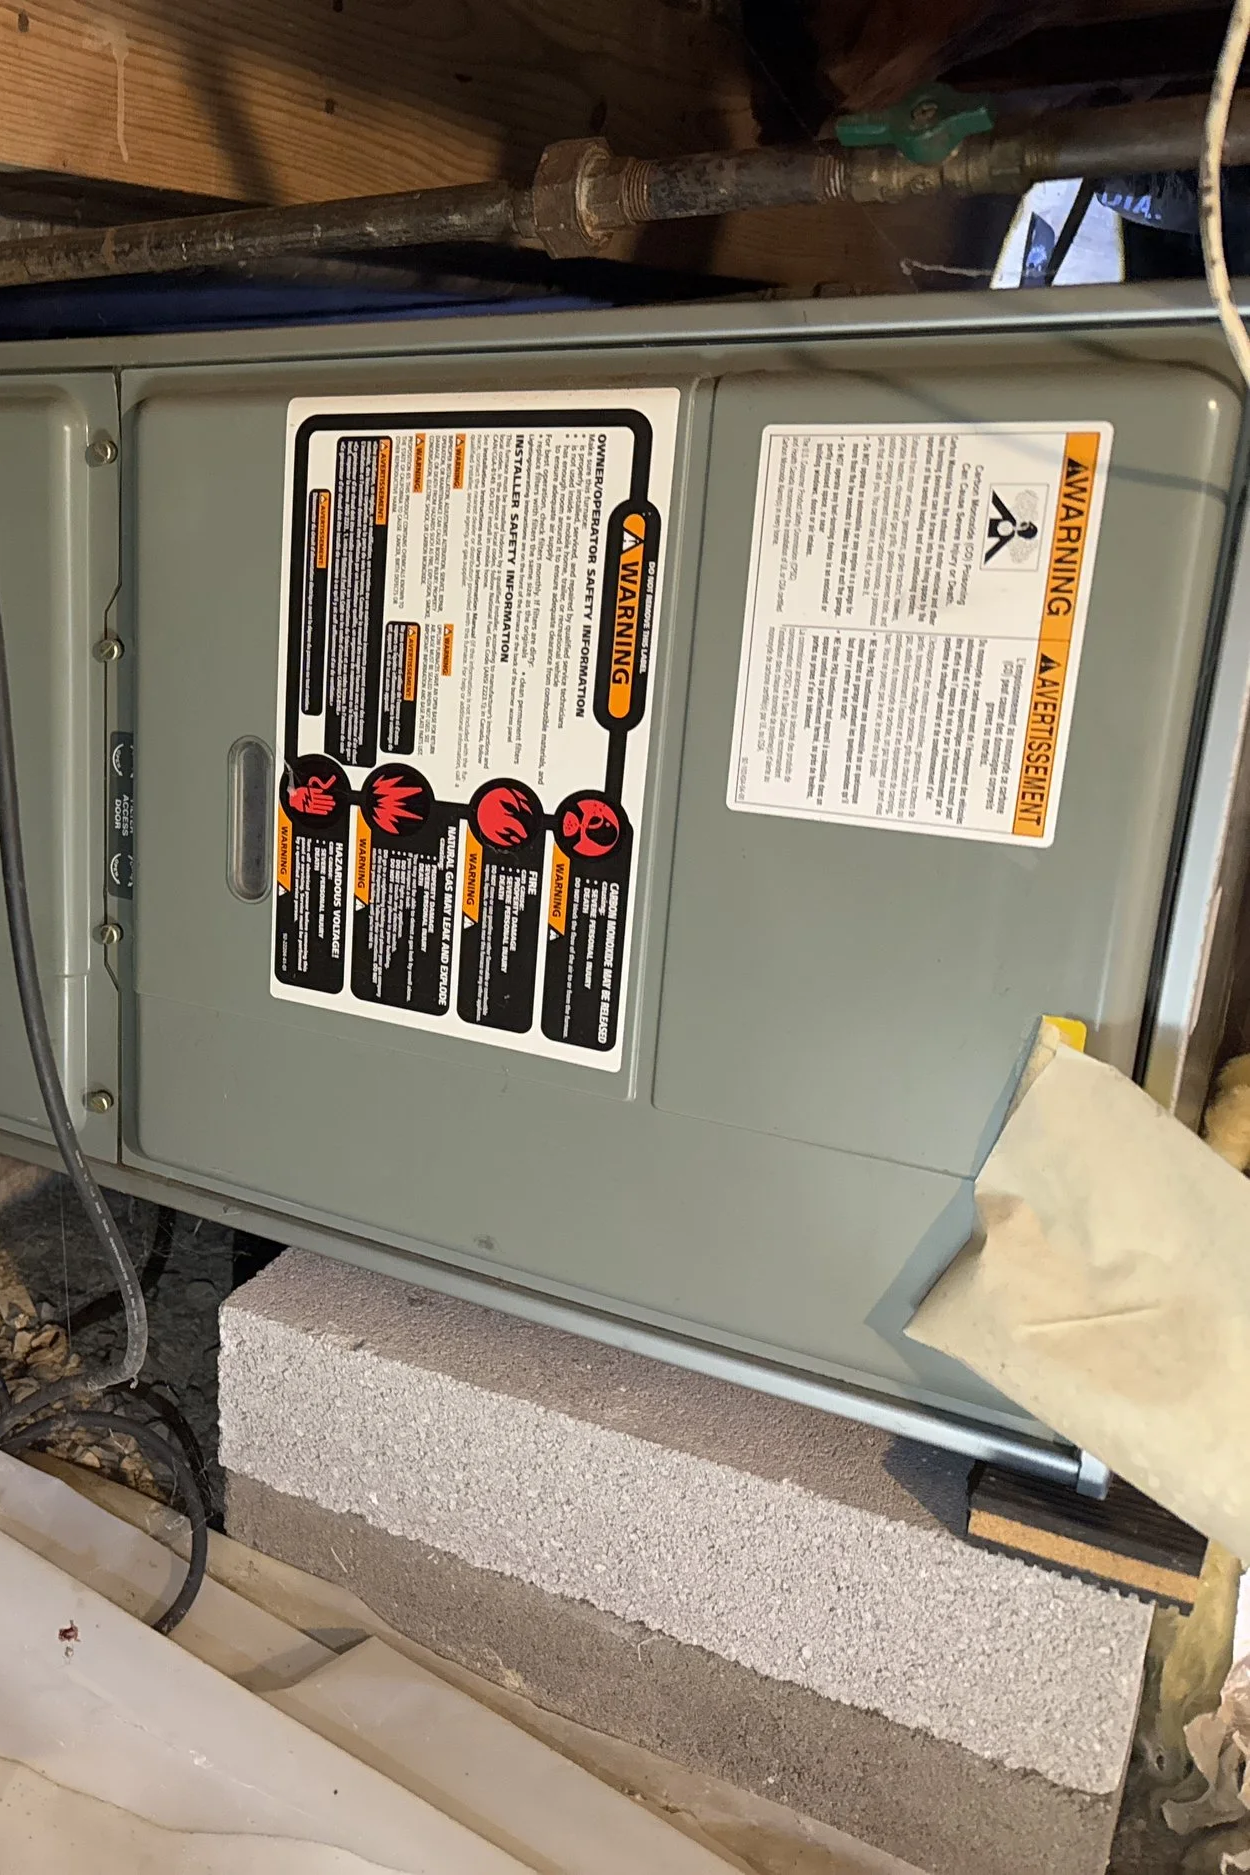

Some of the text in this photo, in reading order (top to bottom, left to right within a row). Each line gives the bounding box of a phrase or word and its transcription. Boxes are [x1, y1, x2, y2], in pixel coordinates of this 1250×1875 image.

[534, 440, 542, 469] replace
[543, 449, 551, 466] best
[544, 434, 552, 447] For
[554, 444, 561, 454] to
[587, 433, 595, 456] Make
[413, 448, 422, 491] WARNING:
[453, 448, 461, 488] WARNING:
[533, 472, 541, 495] filters
[558, 460, 567, 491] enough
[575, 453, 585, 486] properly
[377, 453, 386, 519] AVERTISSEMENT:
[538, 468, 549, 510] operation,
[549, 484, 558, 521] adequate
[566, 490, 574, 513] inside
[531, 497, 539, 516] with
[538, 512, 546, 535] check
[573, 489, 582, 524] installed,
[581, 496, 590, 529] furnace:
[529, 518, 538, 541] filters
[555, 516, 563, 544] around
[563, 522, 572, 549] mobile
[570, 526, 579, 560] serviced,
[944, 463, 970, 606] Can Cause Severe Injury or Death.
[956, 465, 984, 605] Carbon Monoxide (CO) Poisoning
[1046, 476, 1089, 616] WARNING
[500, 434, 524, 662] INSTALLER SAFETY INFORMATION
[536, 537, 545, 561] filters
[545, 535, 554, 561] supply
[554, 554, 561, 563] to
[561, 551, 569, 575] home,
[525, 582, 533, 597] size
[533, 562, 542, 596] monthly.
[559, 577, 567, 602] trailer,
[575, 434, 606, 717] OWNER/OPERATOR SAFETY INFORMATION
[525, 599, 530, 608] as
[549, 592, 557, 628] adequate
[558, 604, 564, 612] or
[566, 579, 575, 611] repaired
[531, 607, 539, 630] filters
[564, 613, 573, 623] by
[611, 561, 638, 685] WARNING
[638, 561, 655, 673] DO NOT REMOVE THIS LABEL
[520, 625, 529, 658] originals
[546, 630, 554, 665] clearance
[555, 614, 563, 659] recreational
[563, 624, 572, 658] qualified
[527, 646, 536, 667] dirty:
[560, 660, 568, 686] service
[545, 667, 553, 686] from
[552, 661, 561, 687] vehicle
[513, 677, 526, 764] clean permanent filters
[541, 686, 551, 732] combustible
[557, 687, 566, 729] technicians
[538, 733, 546, 769] materials,
[1017, 677, 1060, 825] AVERTISSEMENT
[280, 825, 288, 875] WARNING
[357, 838, 366, 888] WARNING
[437, 837, 445, 870] causing:
[466, 852, 477, 905] WARNING
[497, 874, 505, 900] DEATH
[527, 870, 537, 895] FIRE
[552, 862, 564, 917] WARNING
[331, 842, 343, 958] HAZARDOUS VOLTAGE!
[421, 890, 429, 927] PERSONAL
[427, 864, 437, 933] PROPERTY DAMAGE
[509, 876, 520, 951] PROPERTY DAMAGE
[581, 887, 590, 914] DEATH
[597, 880, 607, 916] causing:
[438, 826, 456, 1006] NATURAL GAS MAY LEAK AND EXPLODE
[502, 905, 510, 945] PERSONAL
[583, 888, 598, 989] SEVERE PERSONAL INJURY
[500, 945, 508, 972] INJURY
[597, 882, 619, 1044] CARBON MONOXIDE MAY BE RELEASED
